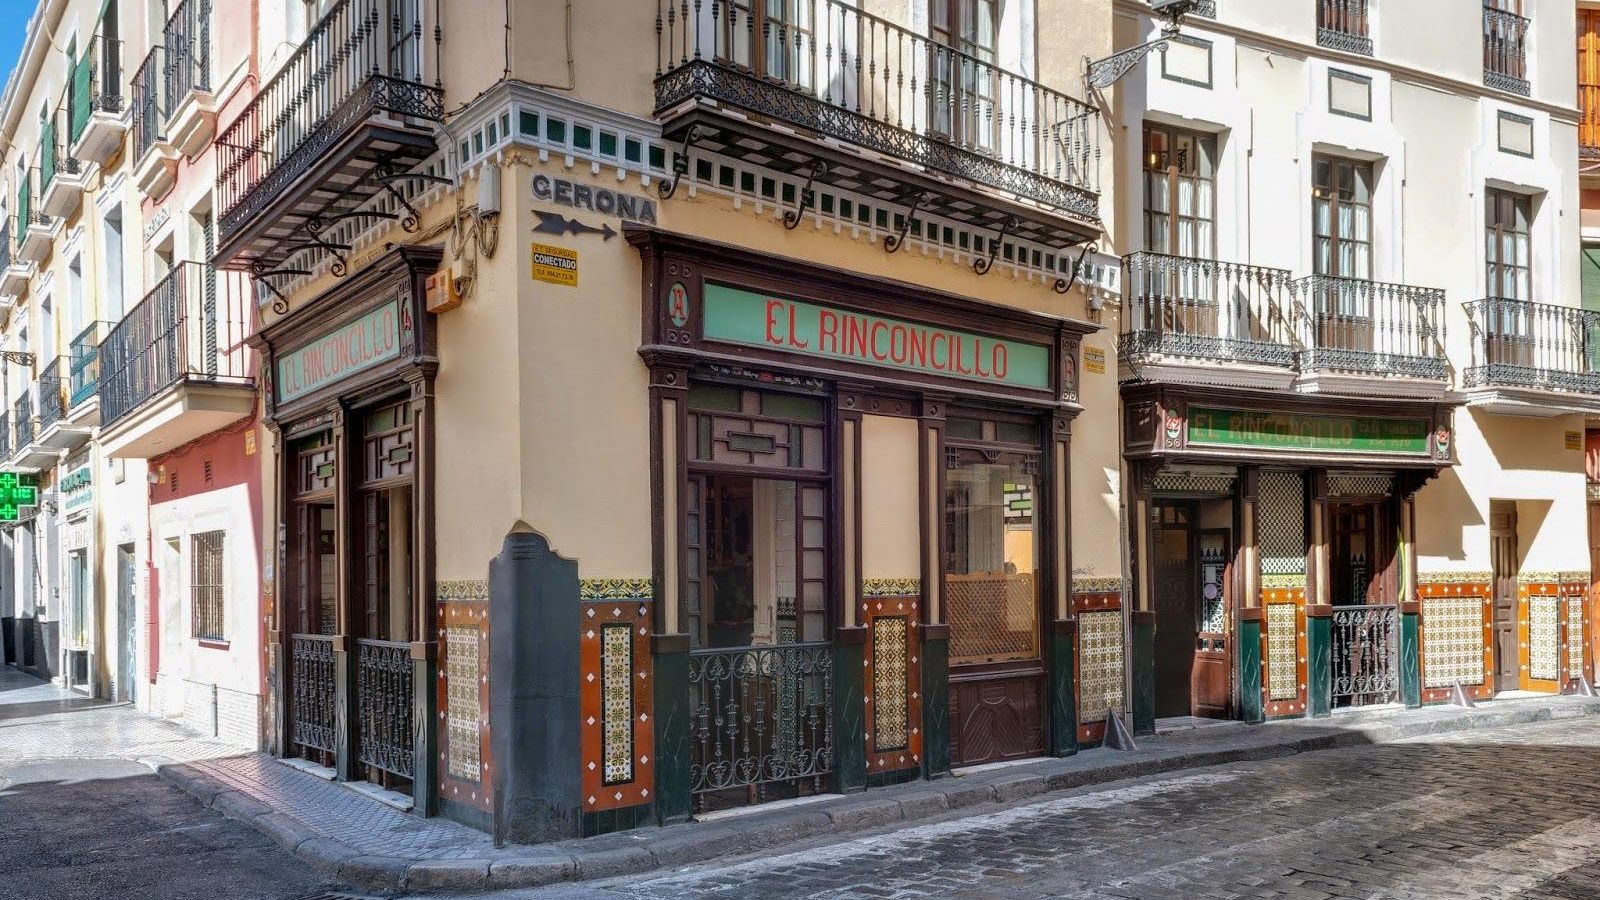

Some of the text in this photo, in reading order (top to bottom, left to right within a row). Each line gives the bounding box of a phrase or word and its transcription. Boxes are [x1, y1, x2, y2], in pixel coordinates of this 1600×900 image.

[532, 174, 657, 223] GERONA
[534, 254, 576, 269] CONECTADO
[284, 309, 393, 395] EL RINCONCILLO
[764, 298, 1008, 379] EL RINCONCILLO
[1194, 413, 1353, 445] EL RINCONCILLO
